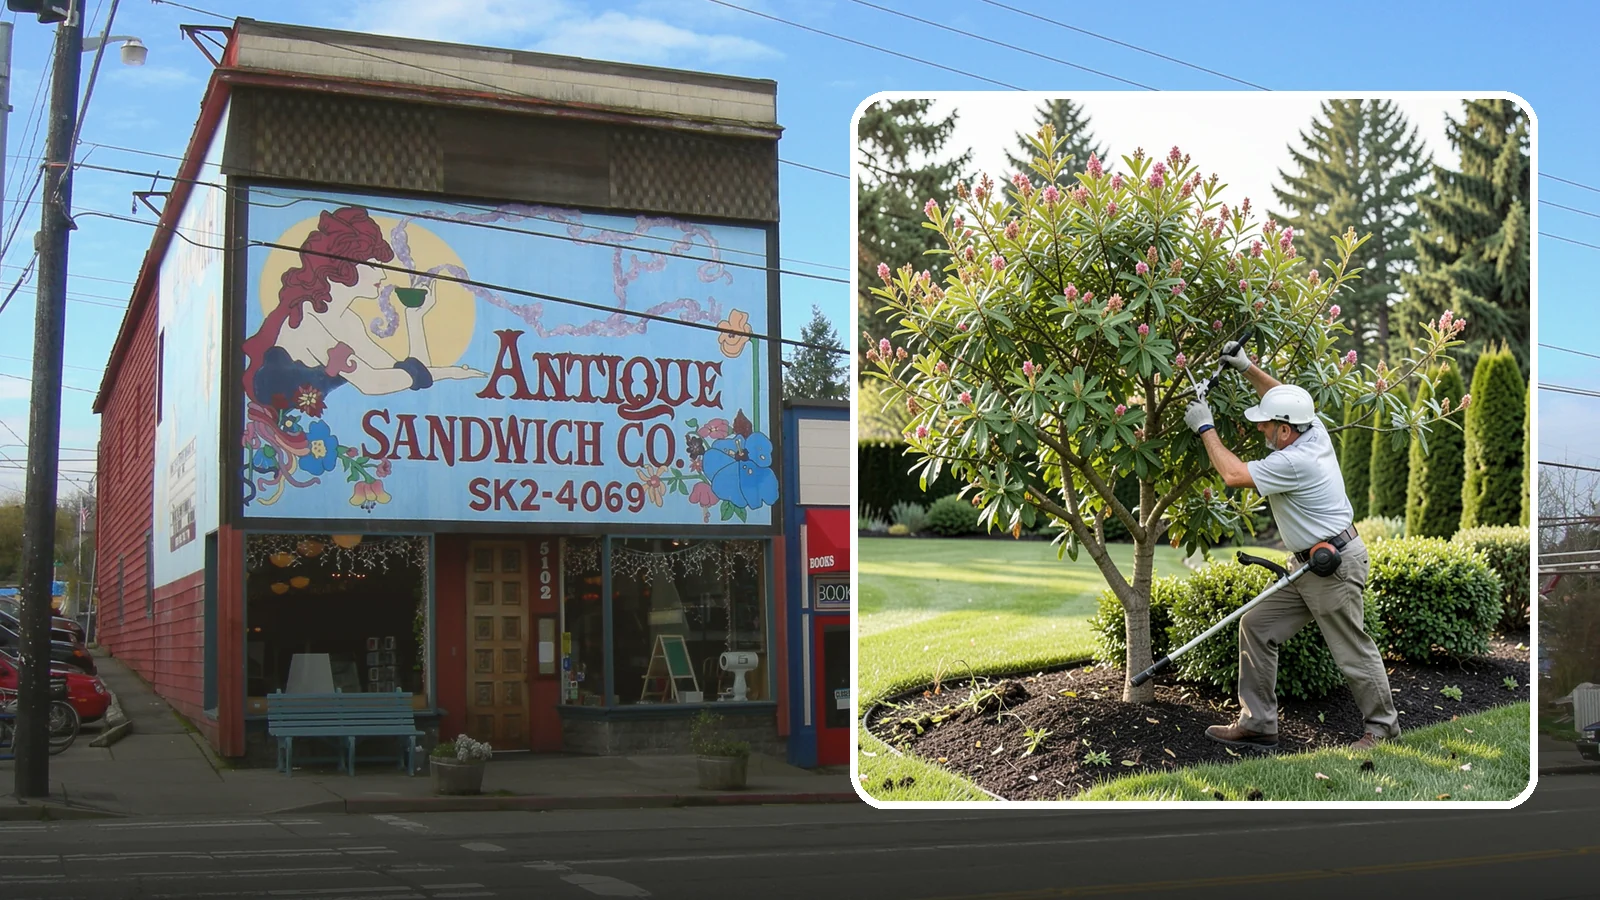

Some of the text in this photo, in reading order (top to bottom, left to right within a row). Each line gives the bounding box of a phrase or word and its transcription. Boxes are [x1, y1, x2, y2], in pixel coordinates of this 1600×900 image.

[476, 329, 723, 420] ANTIQUE
[361, 408, 685, 469] SANDWICH CO.
[468, 477, 646, 513] SK2-4069
[540, 541, 552, 600] 5102
[809, 555, 835, 569] BOOKS
